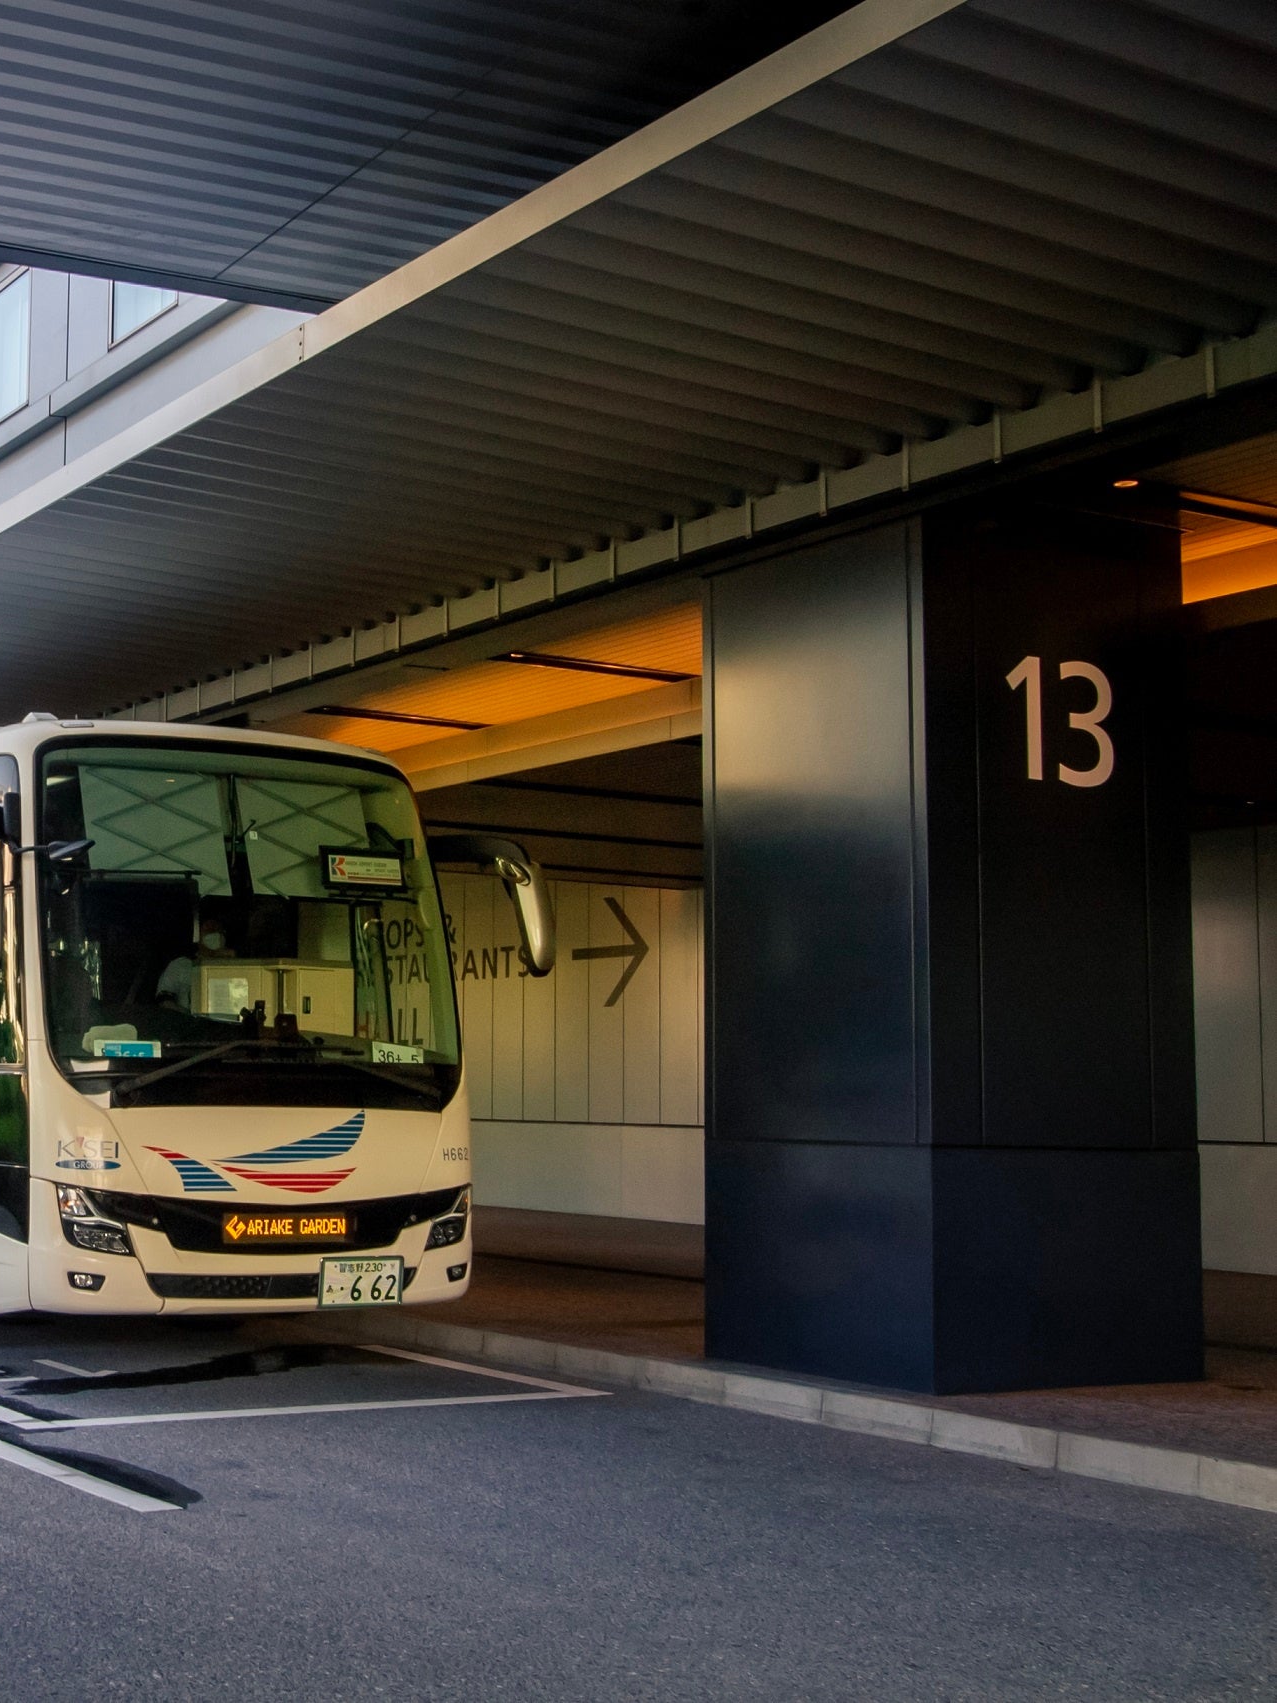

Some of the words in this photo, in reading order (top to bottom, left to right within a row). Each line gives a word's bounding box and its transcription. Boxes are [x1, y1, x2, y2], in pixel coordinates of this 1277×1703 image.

[1005, 655, 1115, 788] 13
[386, 918, 424, 949] OPS
[443, 1147, 469, 1161] H662
[73, 1160, 105, 1170] GROUP
[247, 1219, 293, 1235] ARIAKE
[300, 1218, 346, 1235] GARDEN
